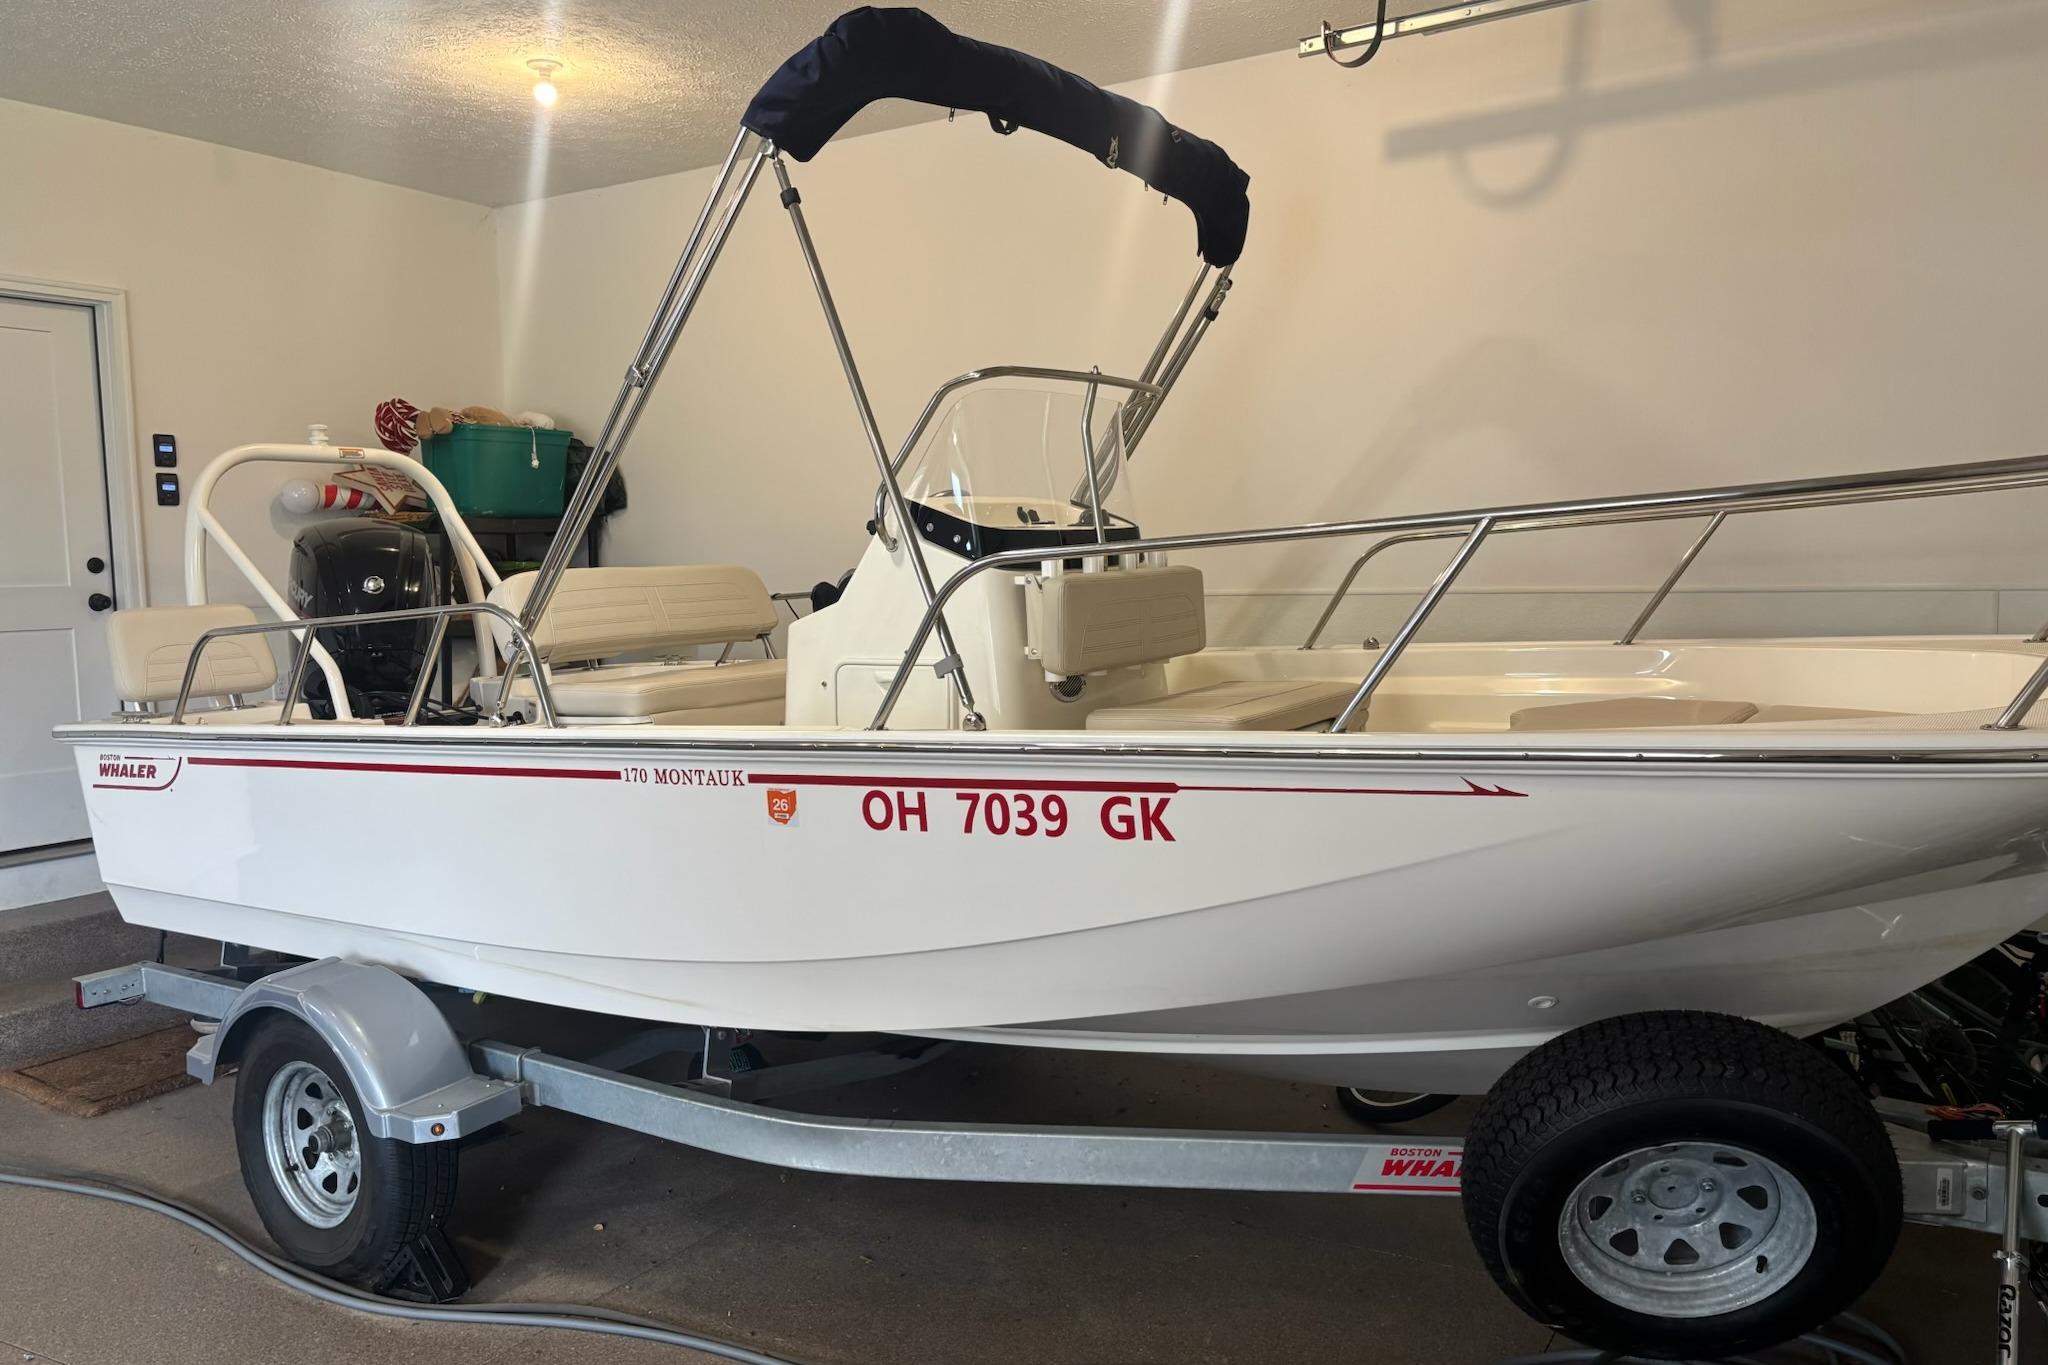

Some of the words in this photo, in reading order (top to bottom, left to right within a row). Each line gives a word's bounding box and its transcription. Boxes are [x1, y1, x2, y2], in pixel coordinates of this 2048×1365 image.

[99, 763, 157, 779] WHALER
[624, 768, 647, 784] 170
[654, 768, 745, 786] MONTAUK
[773, 798, 789, 811] 26
[862, 790, 928, 832] OH
[956, 792, 1068, 837] 7039
[1100, 796, 1176, 841] GK
[1390, 1148, 1442, 1157] BOSTON
[1999, 1285, 2016, 1358] Razor
